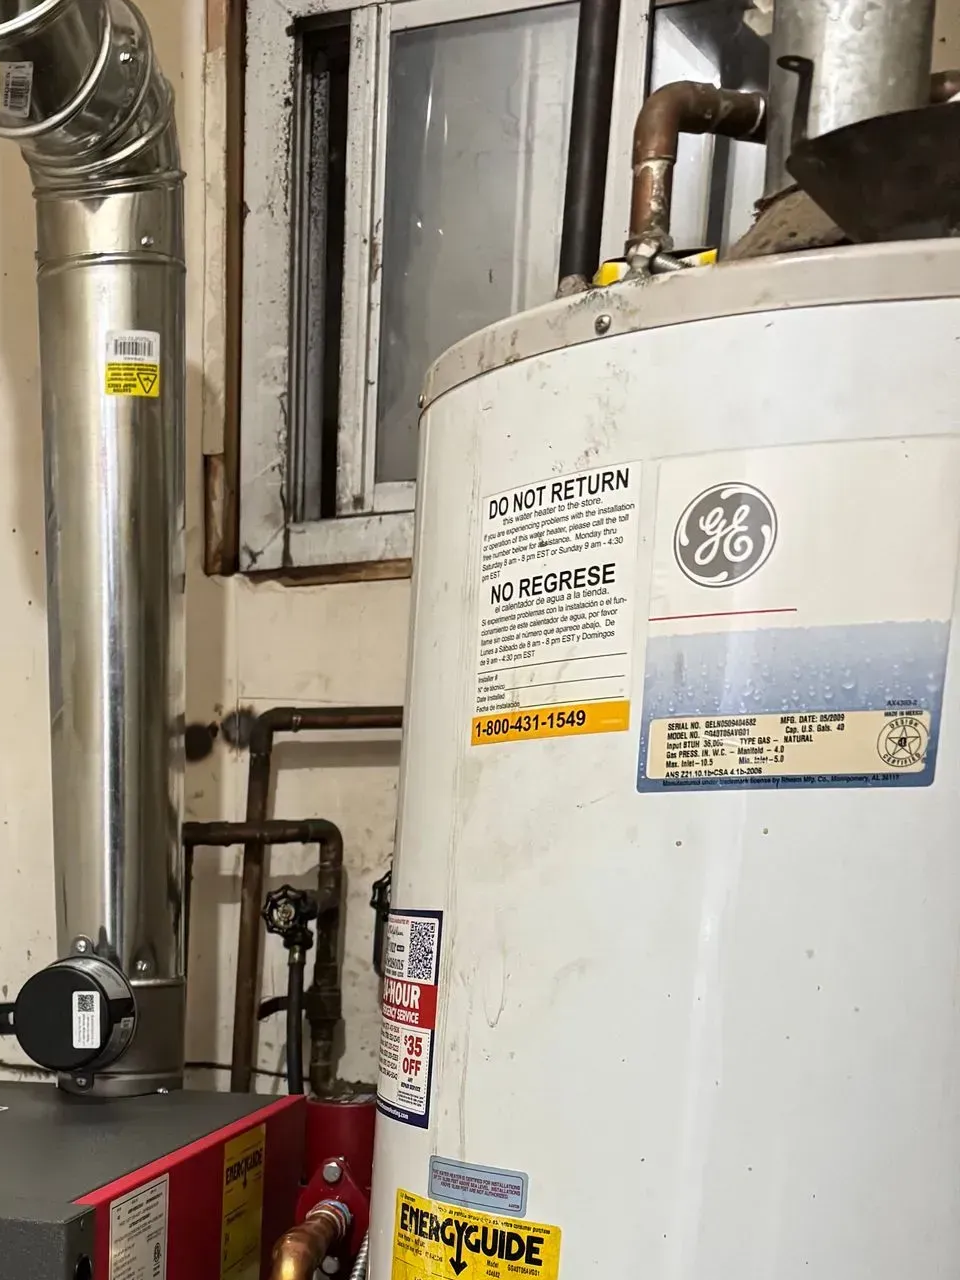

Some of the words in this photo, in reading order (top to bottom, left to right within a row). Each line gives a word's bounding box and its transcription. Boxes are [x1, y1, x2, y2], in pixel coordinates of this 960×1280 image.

[489, 496, 509, 519] DO
[513, 486, 546, 513] NOT
[551, 469, 629, 503] RETURN
[503, 517, 513, 526] this
[515, 512, 533, 522] water
[534, 507, 556, 517] heater
[567, 502, 579, 510] the
[581, 499, 603, 507] store.
[696, 505, 754, 564] GE
[491, 581, 514, 604] NO
[519, 564, 616, 598] REGRESE
[495, 606, 501, 614] el
[502, 600, 535, 613] calentador
[536, 598, 545, 606] de
[546, 595, 565, 605] agua
[583, 588, 610, 598] tienda.
[476, 710, 586, 738] 1-800-431-1549
[668, 722, 689, 731] SERIAL
[785, 726, 799, 735] Cap.
[819, 714, 845, 723] 05/2009
[740, 737, 756, 745] TYPE
[784, 734, 813, 743] NATURAL
[397, 1009, 419, 1024] SERVICE
[404, 1035, 422, 1057] $35
[403, 1058, 421, 1076] OFF
[400, 1203, 544, 1266] ENERGYGUIDE
